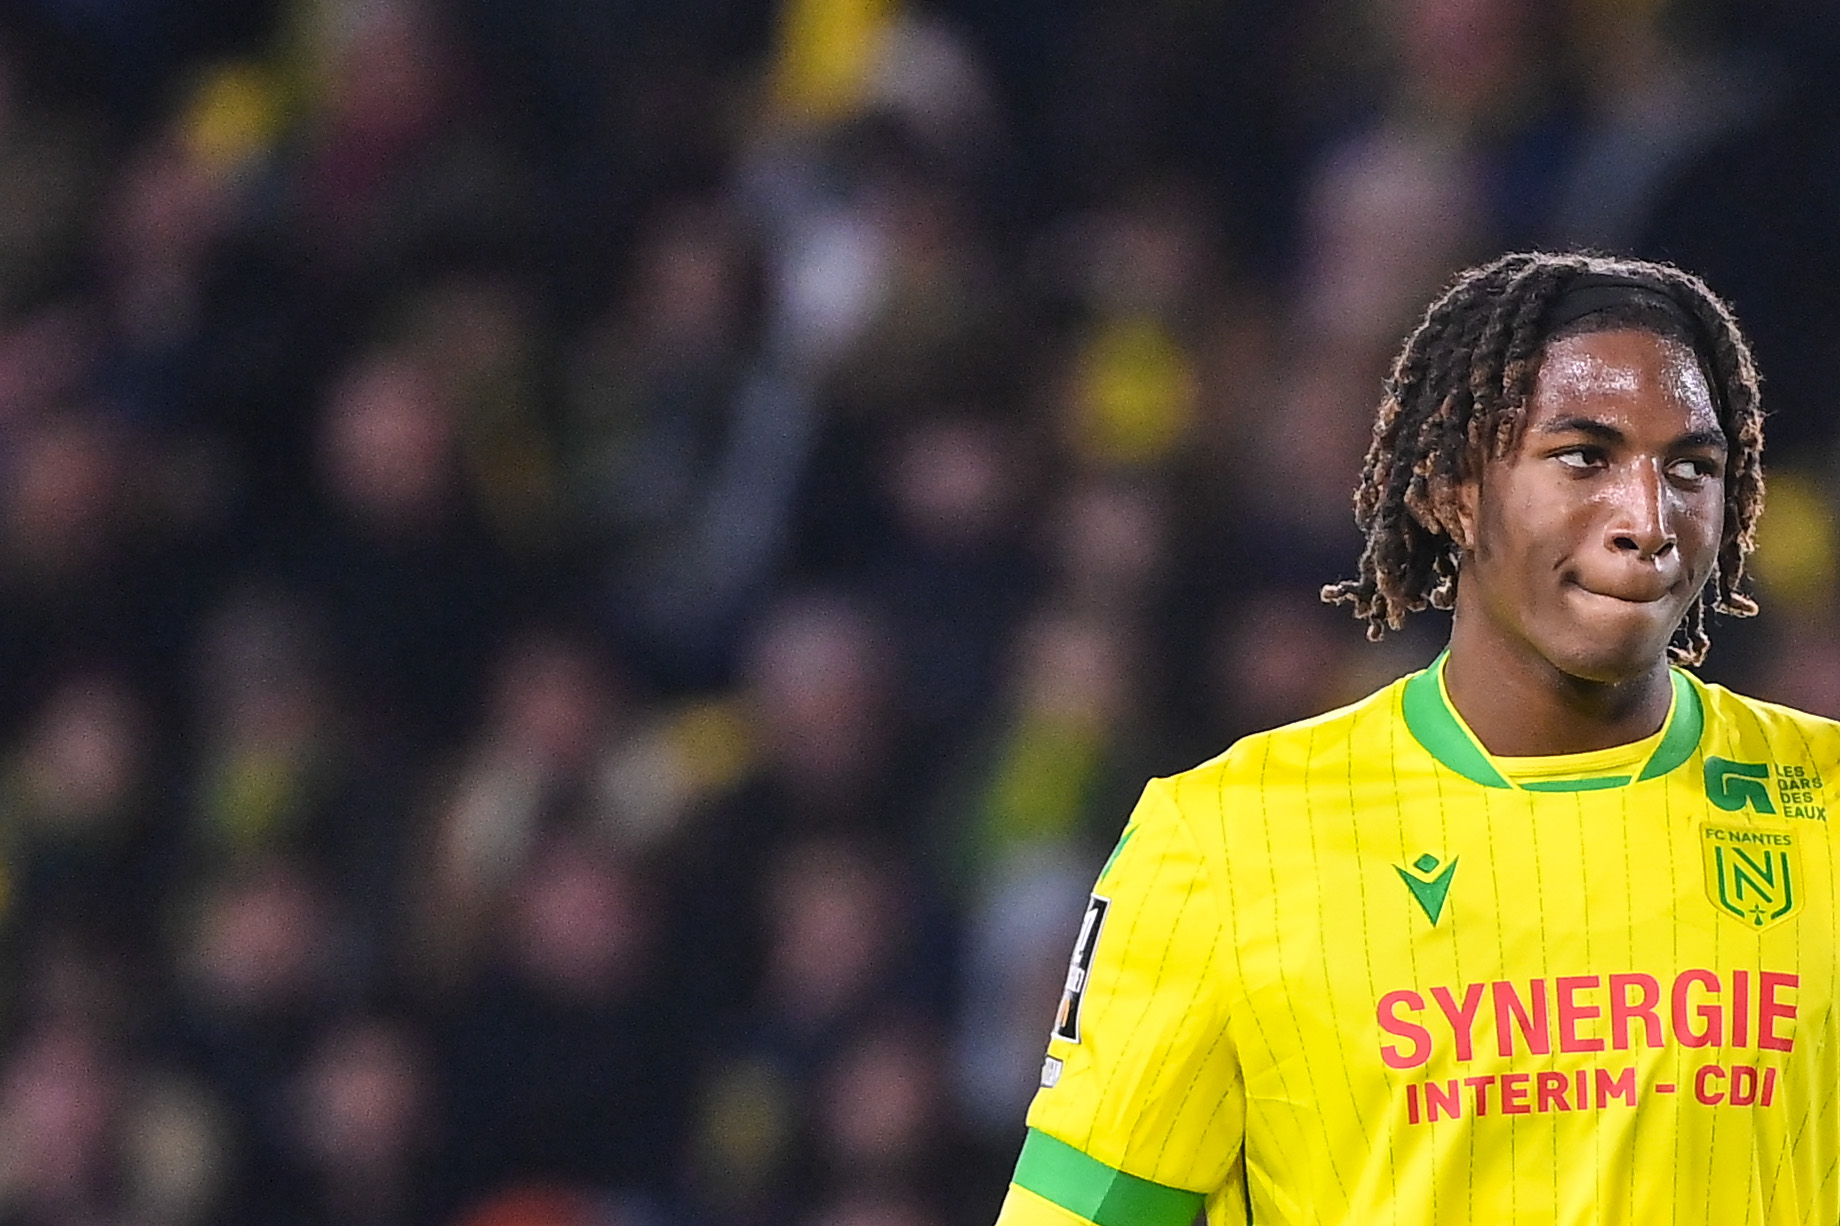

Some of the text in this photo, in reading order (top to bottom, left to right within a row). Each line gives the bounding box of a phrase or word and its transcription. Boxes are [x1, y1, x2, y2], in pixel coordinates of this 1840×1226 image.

[1775, 764, 1805, 778] LES
[1781, 792, 1814, 804] DES
[1784, 805, 1827, 821] EAUX
[1705, 828, 1792, 846] FC NANTES
[1376, 969, 1800, 1069] SYNERGIE
[1406, 1067, 1638, 1125] INTERIM
[1694, 1065, 1776, 1107] CDI
